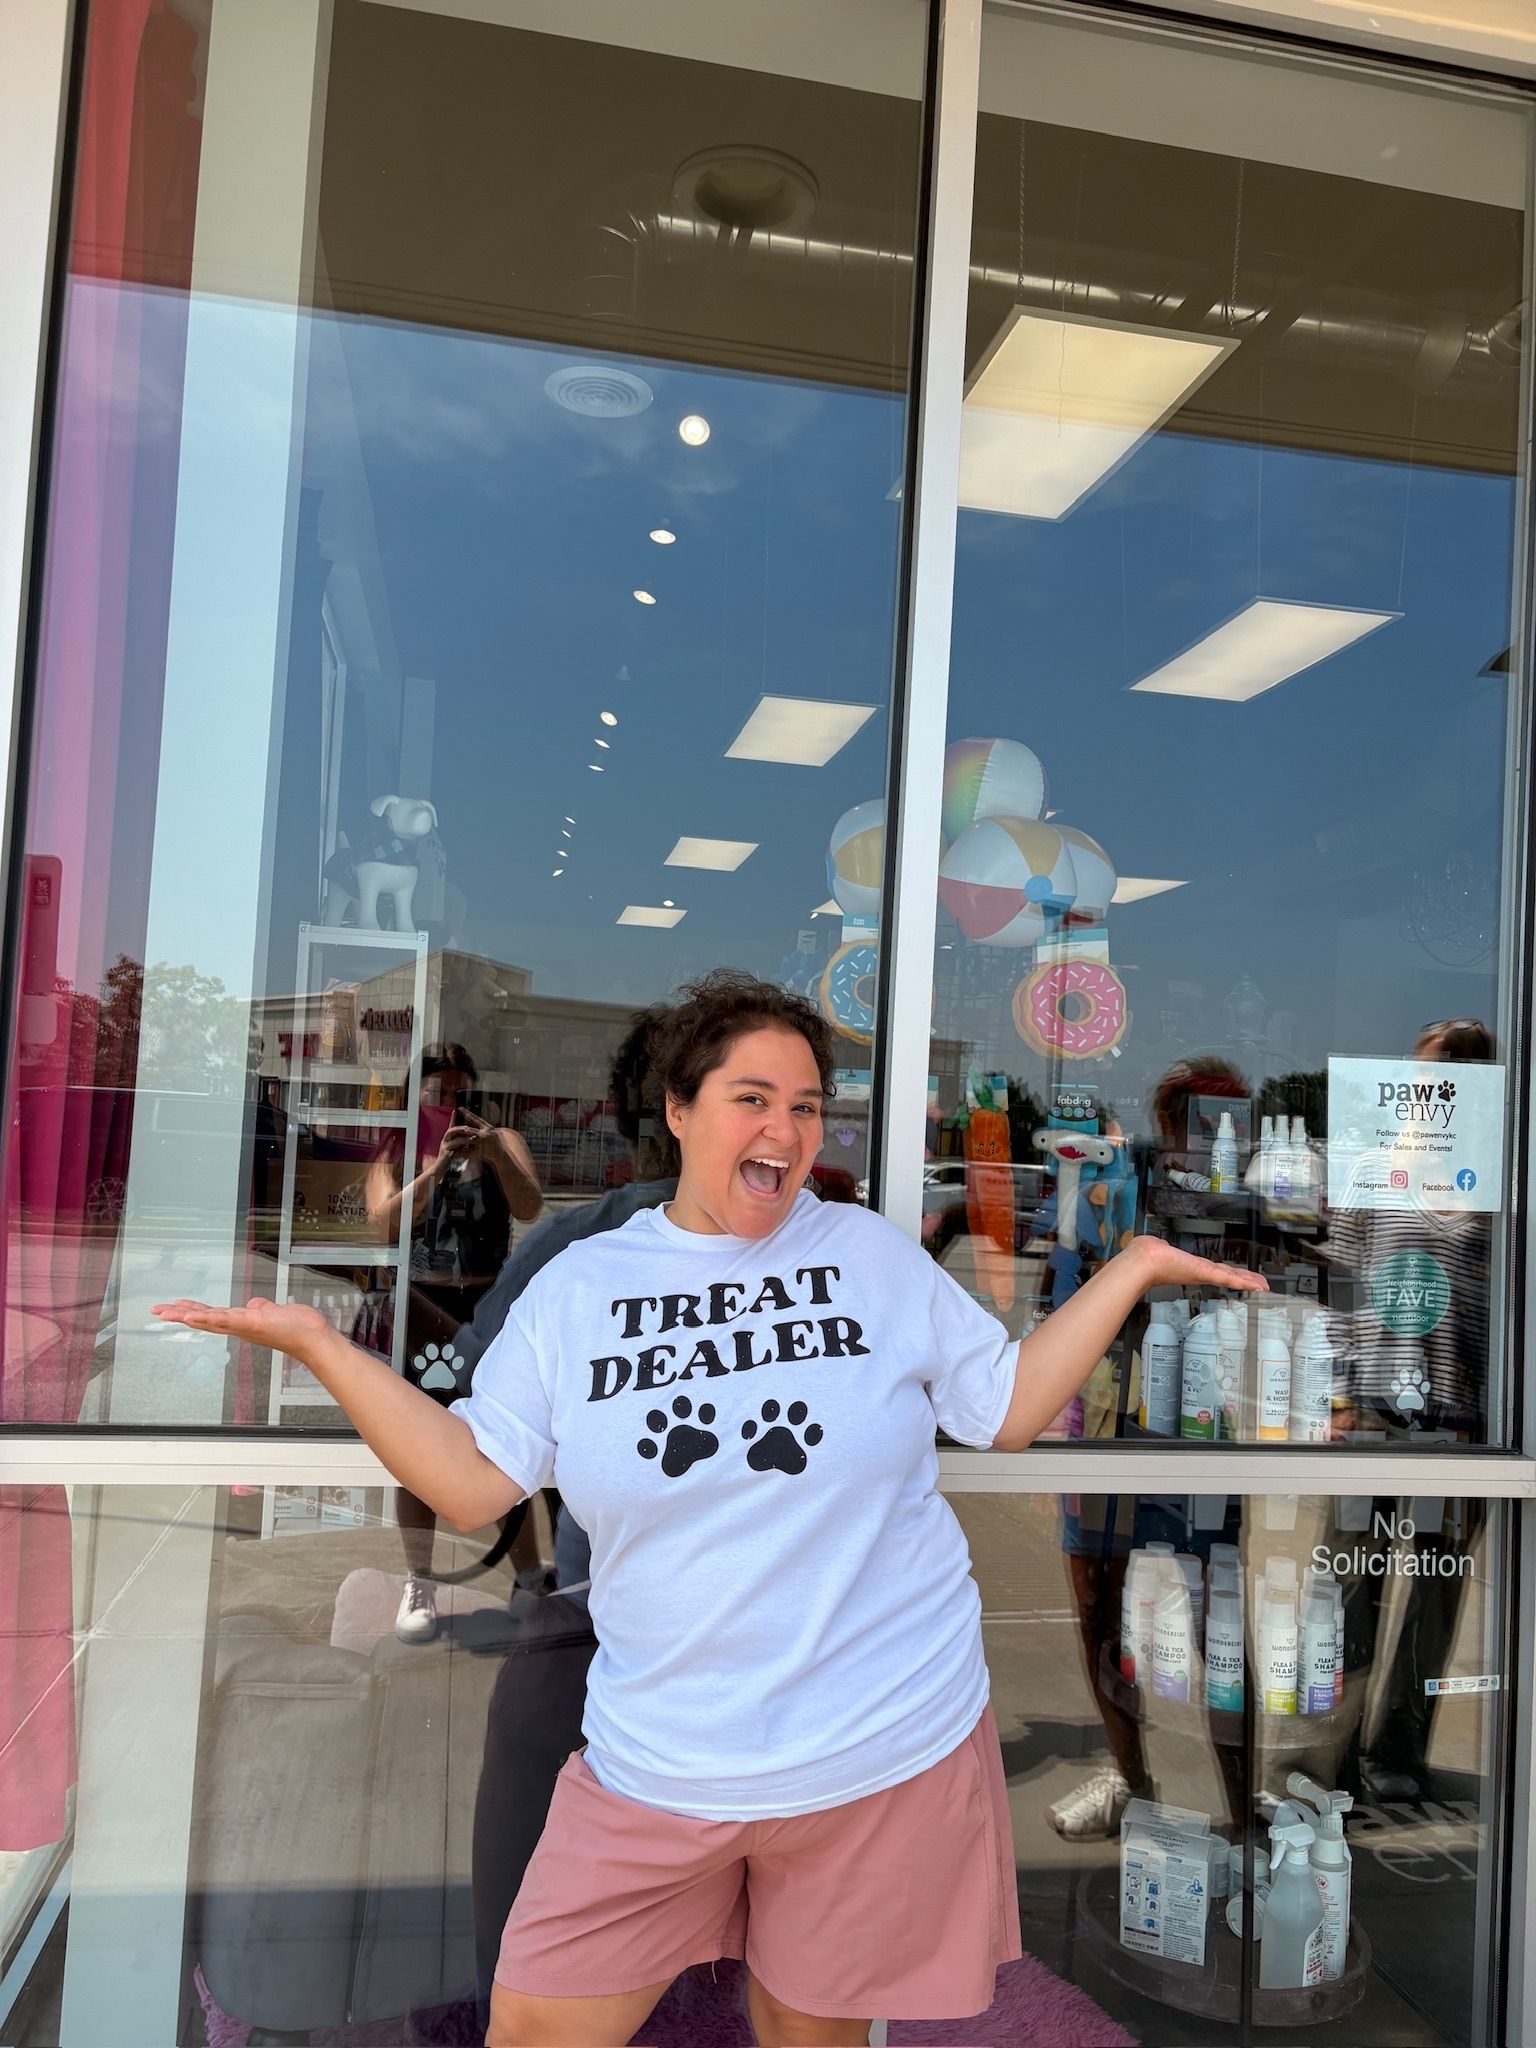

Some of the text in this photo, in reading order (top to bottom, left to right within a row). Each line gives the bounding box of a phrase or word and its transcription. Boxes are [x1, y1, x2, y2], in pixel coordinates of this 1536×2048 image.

[1378, 1082, 1435, 1107] paw
[1395, 1102, 1456, 1129] envy
[1376, 1129, 1400, 1137] Follow
[1412, 1130, 1456, 1141] @pawenvykc
[1379, 1142, 1392, 1150] For
[1394, 1143, 1412, 1151] Sales
[1353, 1181, 1455, 1192] Instagram Facebook
[611, 1266, 841, 1339] TREAT
[1387, 1288, 1436, 1307] FAVE
[587, 1317, 871, 1402] DEALER
[1373, 1511, 1416, 1540] No
[1311, 1544, 1475, 1577] Solicitation
